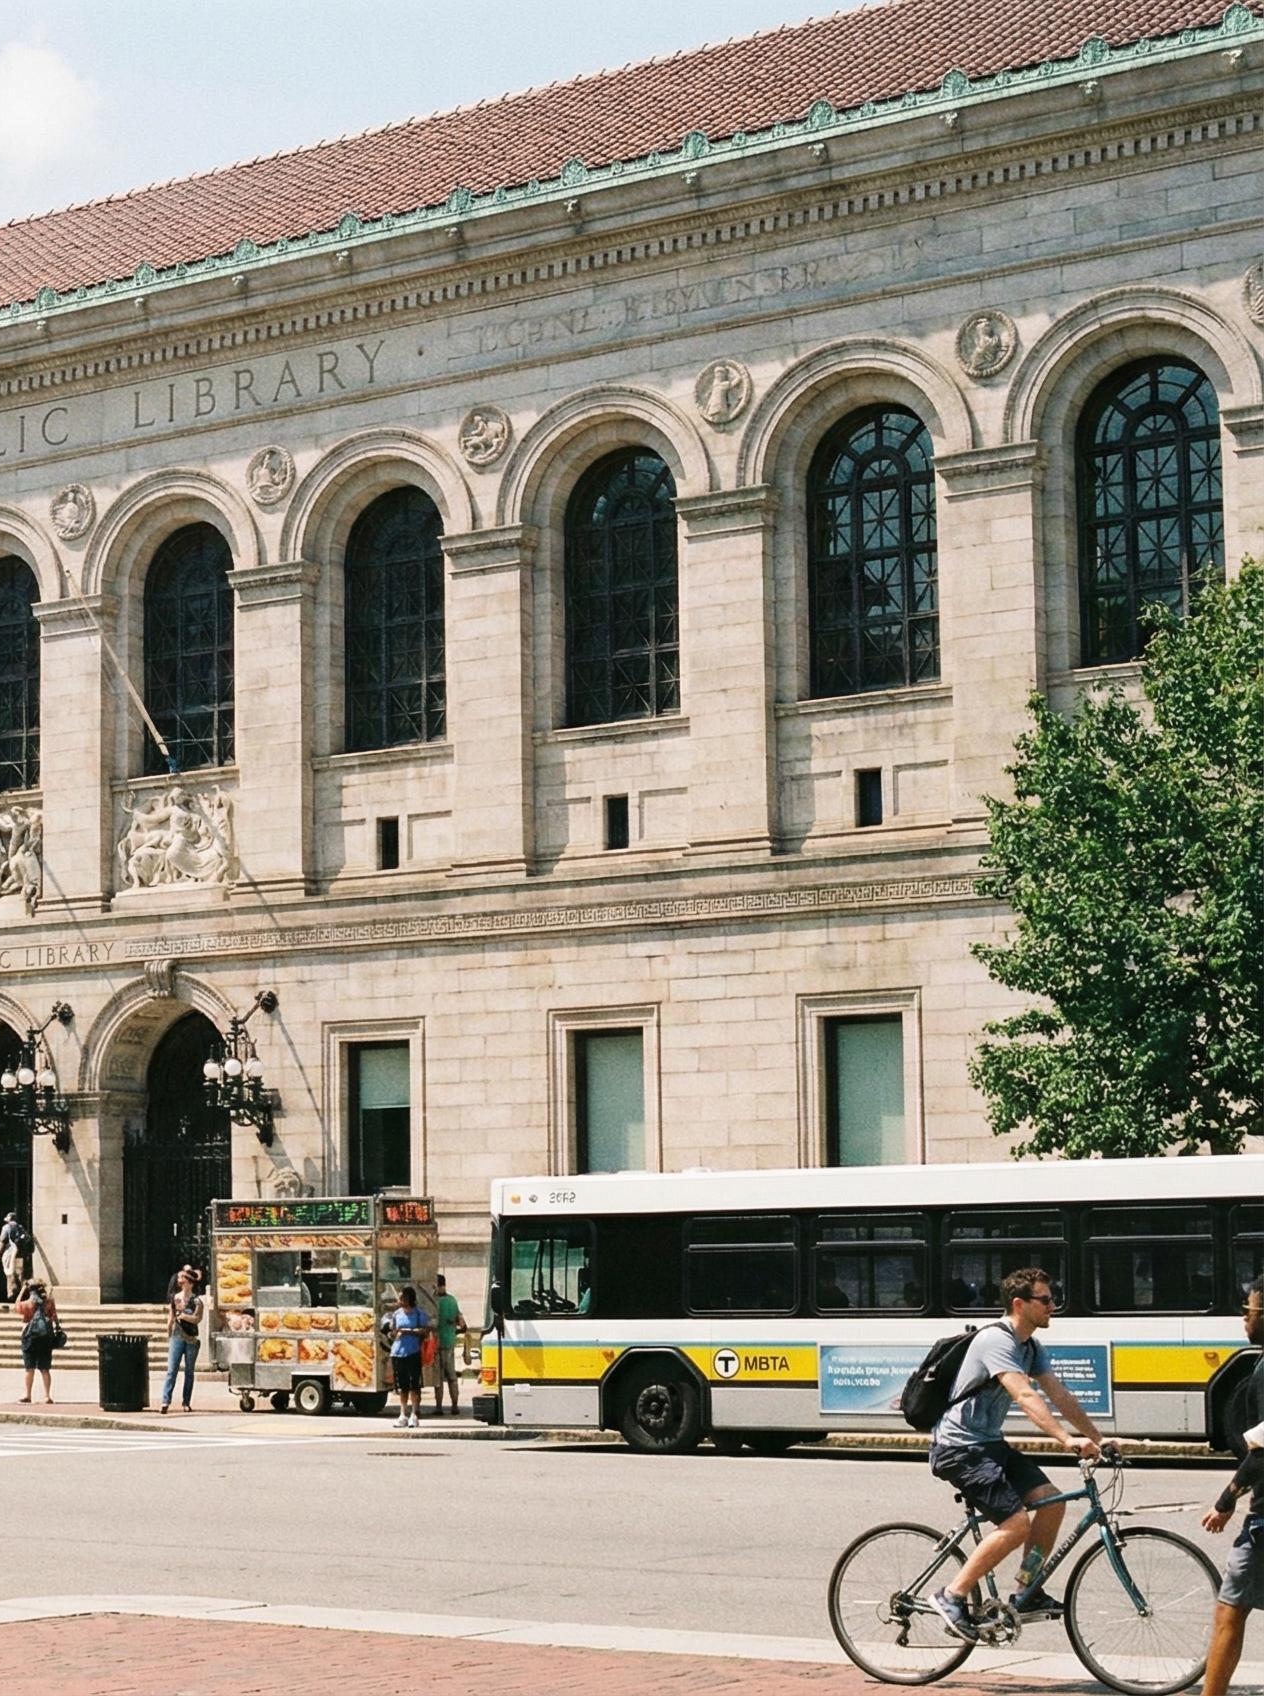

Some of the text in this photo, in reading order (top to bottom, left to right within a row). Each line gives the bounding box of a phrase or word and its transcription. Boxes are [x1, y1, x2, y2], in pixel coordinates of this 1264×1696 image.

[134, 339, 385, 429] LIBRARY
[25, 942, 115, 967] LIBRARY
[718, 1356, 790, 1373] T MBTA
